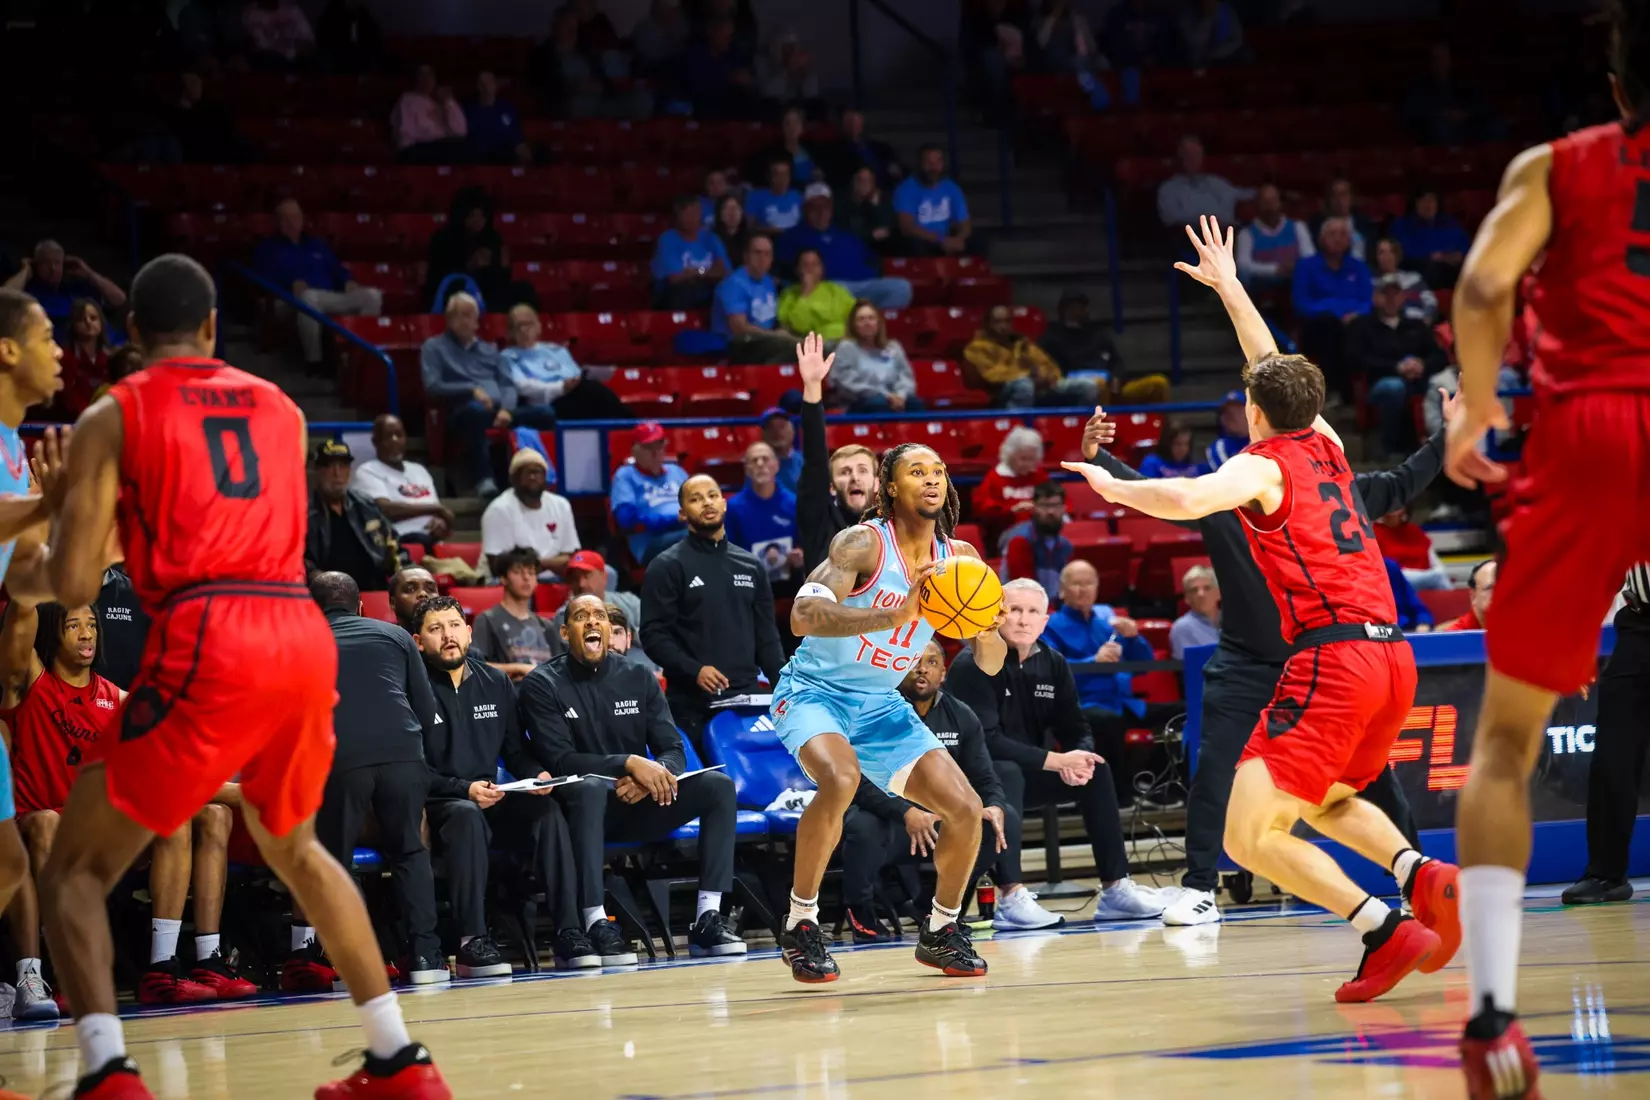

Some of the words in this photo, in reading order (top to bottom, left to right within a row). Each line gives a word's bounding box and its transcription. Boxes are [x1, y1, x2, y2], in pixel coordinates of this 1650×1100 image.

[178, 386, 256, 408] EVANS
[202, 416, 262, 499] 0
[888, 620, 919, 649] 11
[473, 703, 497, 713] RAGIN'
[614, 699, 639, 709] RAGIN'
[473, 710, 499, 720] CAJUNS
[614, 706, 640, 716] CAJUNS
